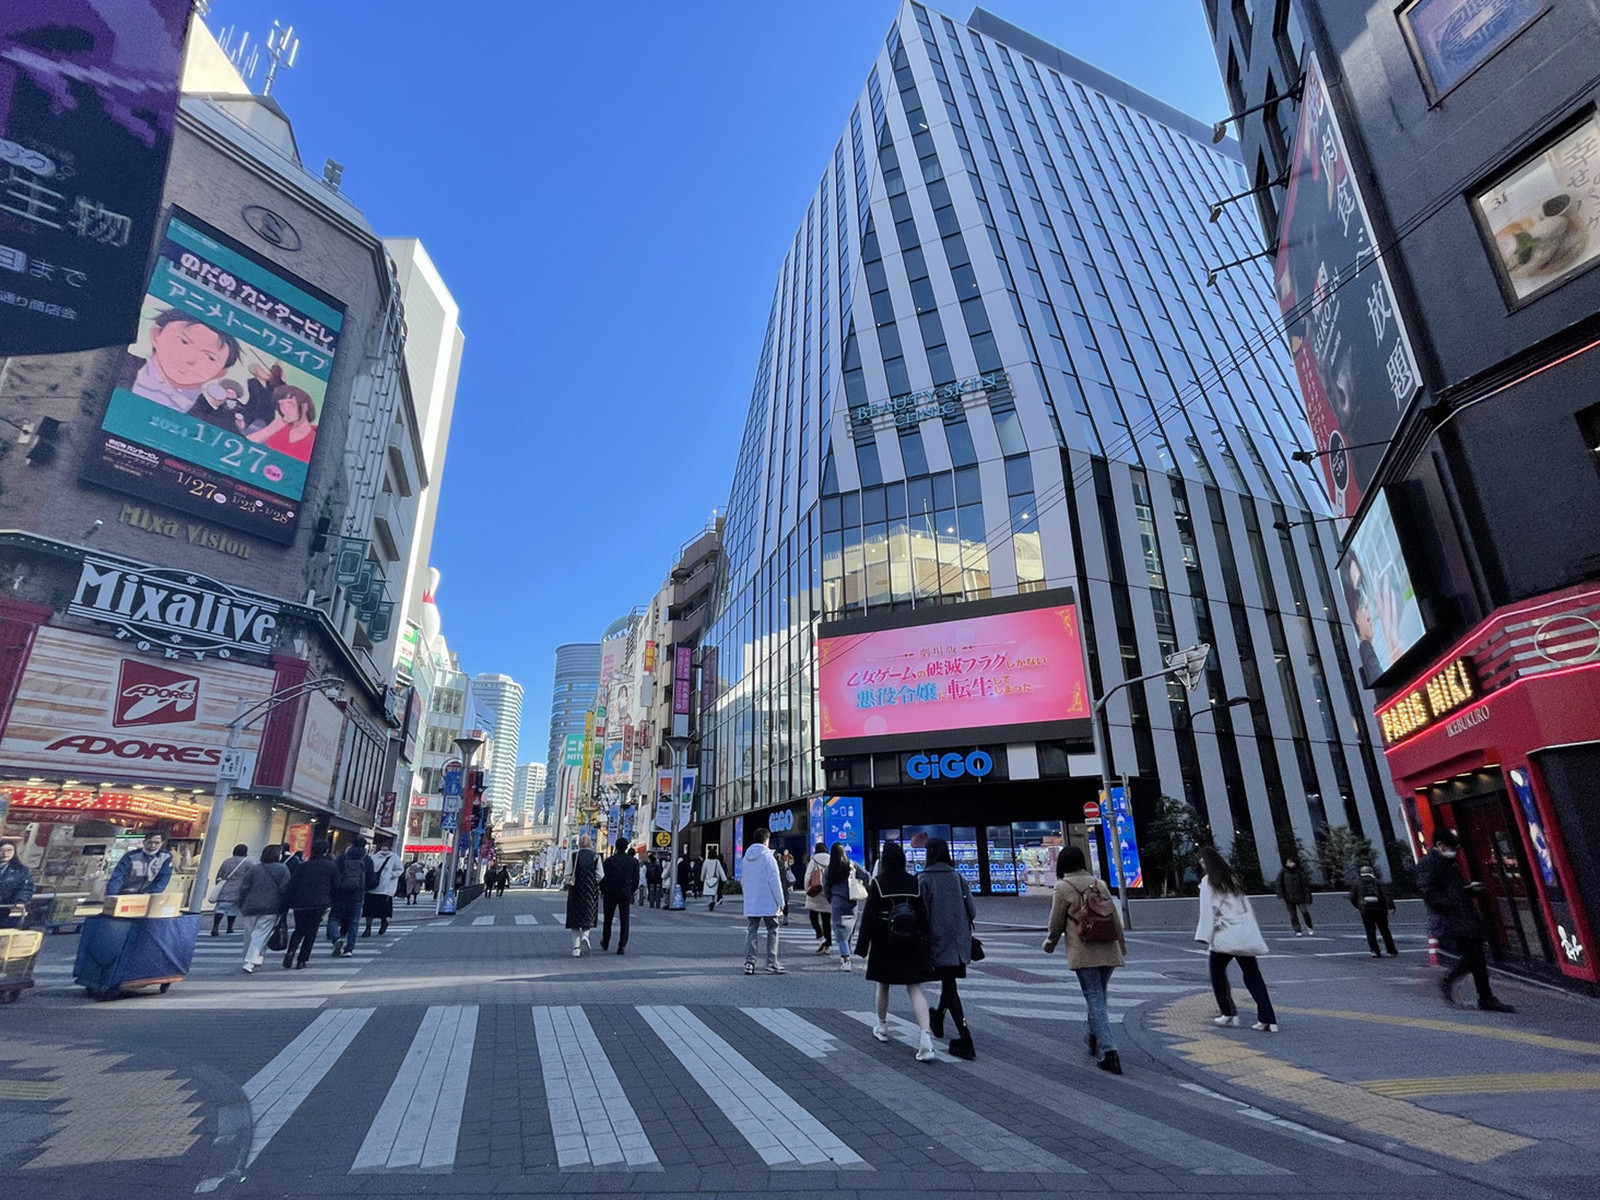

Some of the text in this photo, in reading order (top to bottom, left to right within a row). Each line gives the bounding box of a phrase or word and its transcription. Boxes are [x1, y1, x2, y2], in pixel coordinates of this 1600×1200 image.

[180, 252, 334, 344] のだめ カンタービレ
[168, 280, 330, 370] アニメトークライブ
[856, 373, 998, 421] BEAUTY SKIN
[893, 401, 956, 428] CLINIC
[149, 415, 188, 438] 2024
[193, 423, 269, 474] 1/27
[176, 471, 218, 500] 1/27
[117, 503, 251, 560] Mixa Vision
[70, 562, 277, 645] Mixalive
[115, 626, 231, 661] TOKYO
[123, 684, 196, 701] ADORES
[1381, 658, 1474, 743] PARIS MIKI
[1445, 704, 1490, 738] IKEBUKURO
[44, 734, 223, 766] ADORES
[905, 750, 993, 782] GiGO
[768, 809, 794, 833] GiGO
